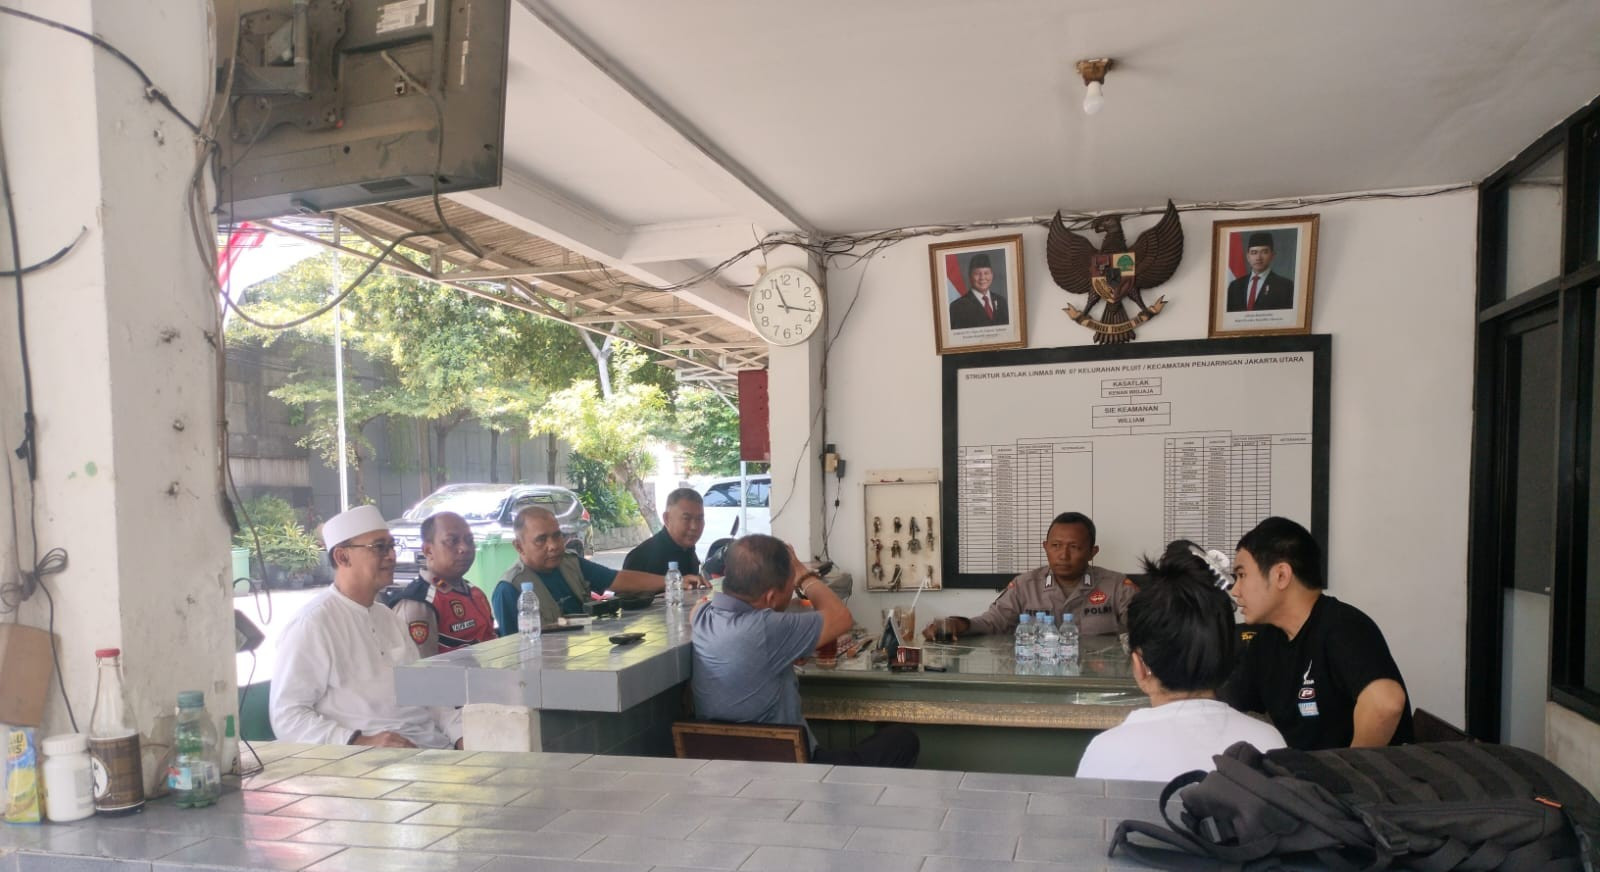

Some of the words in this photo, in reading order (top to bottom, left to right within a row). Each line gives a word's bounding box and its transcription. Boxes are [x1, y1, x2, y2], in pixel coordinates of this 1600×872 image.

[770, 279, 778, 290] 11
[780, 274, 791, 286] 12
[796, 277, 800, 288] 1
[760, 289, 772, 300] 10
[803, 287, 811, 298] 2
[756, 303, 764, 314] 9
[808, 300, 816, 311] 3
[761, 316, 769, 327] 8
[804, 314, 812, 324] 4
[774, 325, 780, 336] 7
[783, 328, 791, 339] 6
[795, 324, 802, 335] 5
[965, 372, 1000, 380] STRUKTUR
[1028, 369, 1053, 377] LINMAS
[1078, 365, 1120, 374] KELURAHAN
[1192, 359, 1243, 368] PENJARINGAN
[1084, 606, 1112, 616] POLRI
